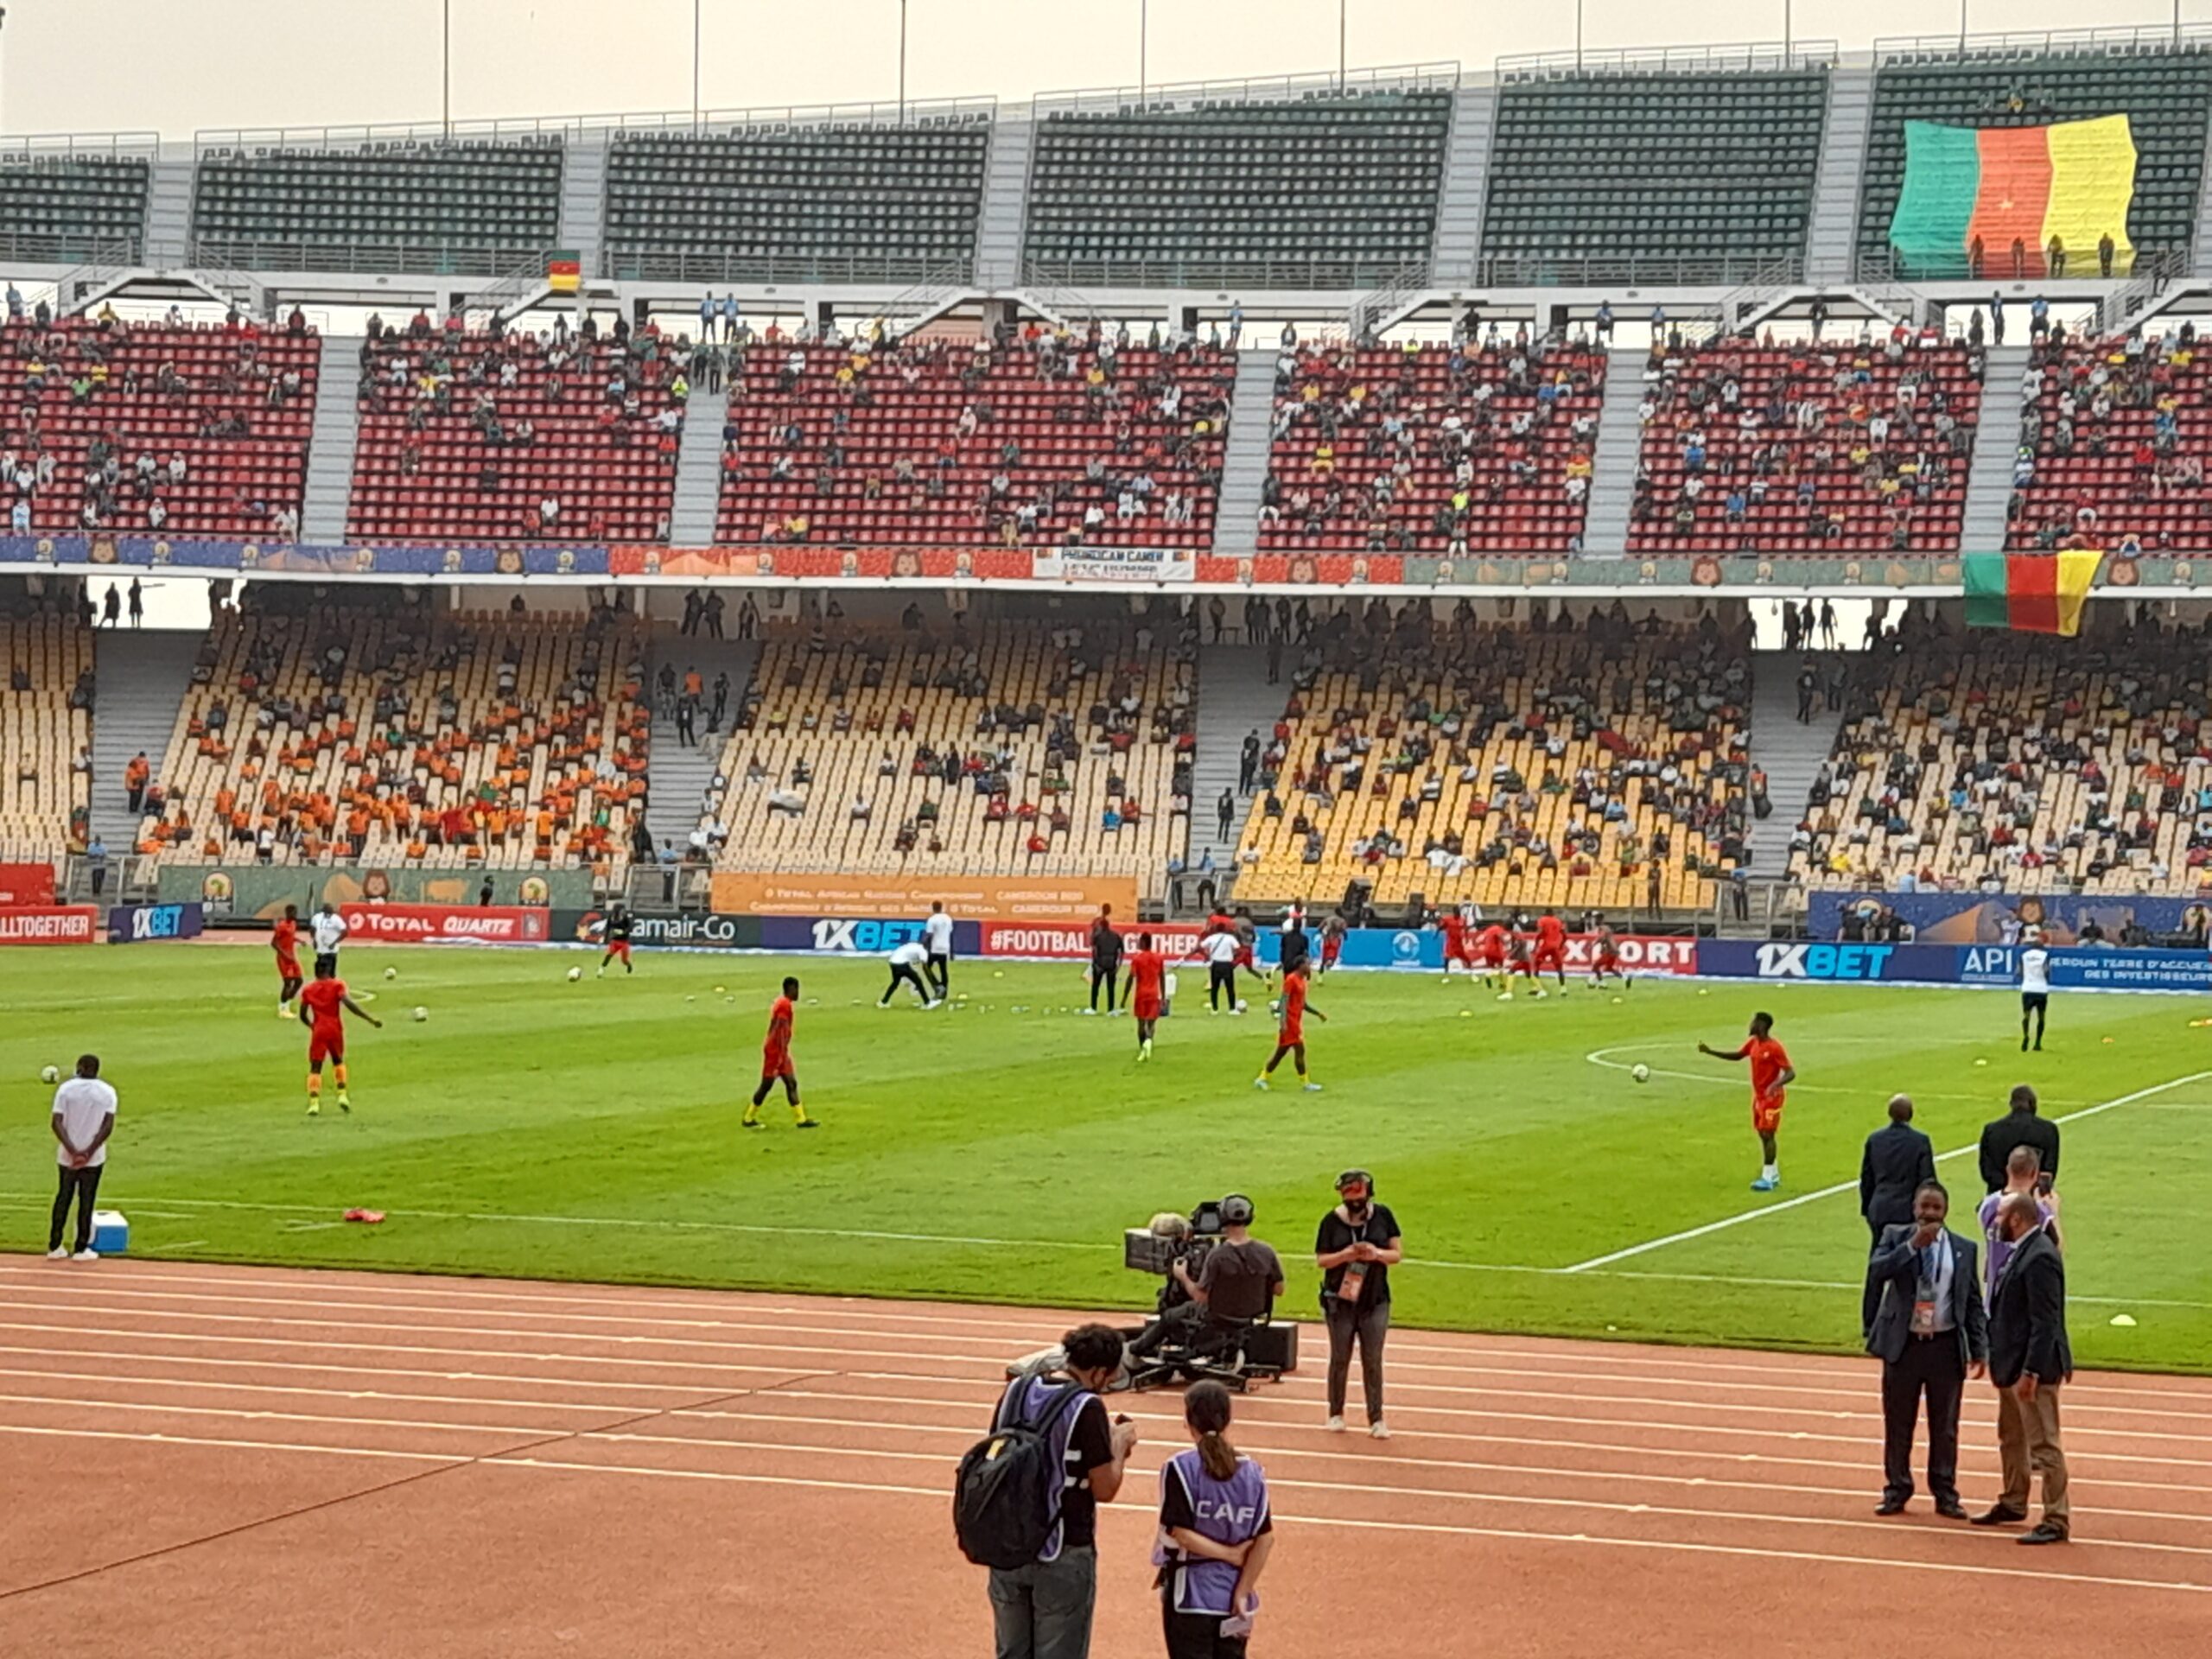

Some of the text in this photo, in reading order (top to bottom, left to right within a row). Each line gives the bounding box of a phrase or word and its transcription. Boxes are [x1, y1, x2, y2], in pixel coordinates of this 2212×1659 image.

[0, 914, 89, 937] LLTOGETHER
[132, 906, 182, 938] 1XBET
[366, 913, 514, 934] TOTAL QUARTZ
[629, 912, 736, 940] amair-Co
[812, 918, 928, 950] 1XBET
[1756, 944, 1893, 977] 1XBET
[1964, 947, 2012, 973] API
[1197, 1500, 1255, 1524] CAF
